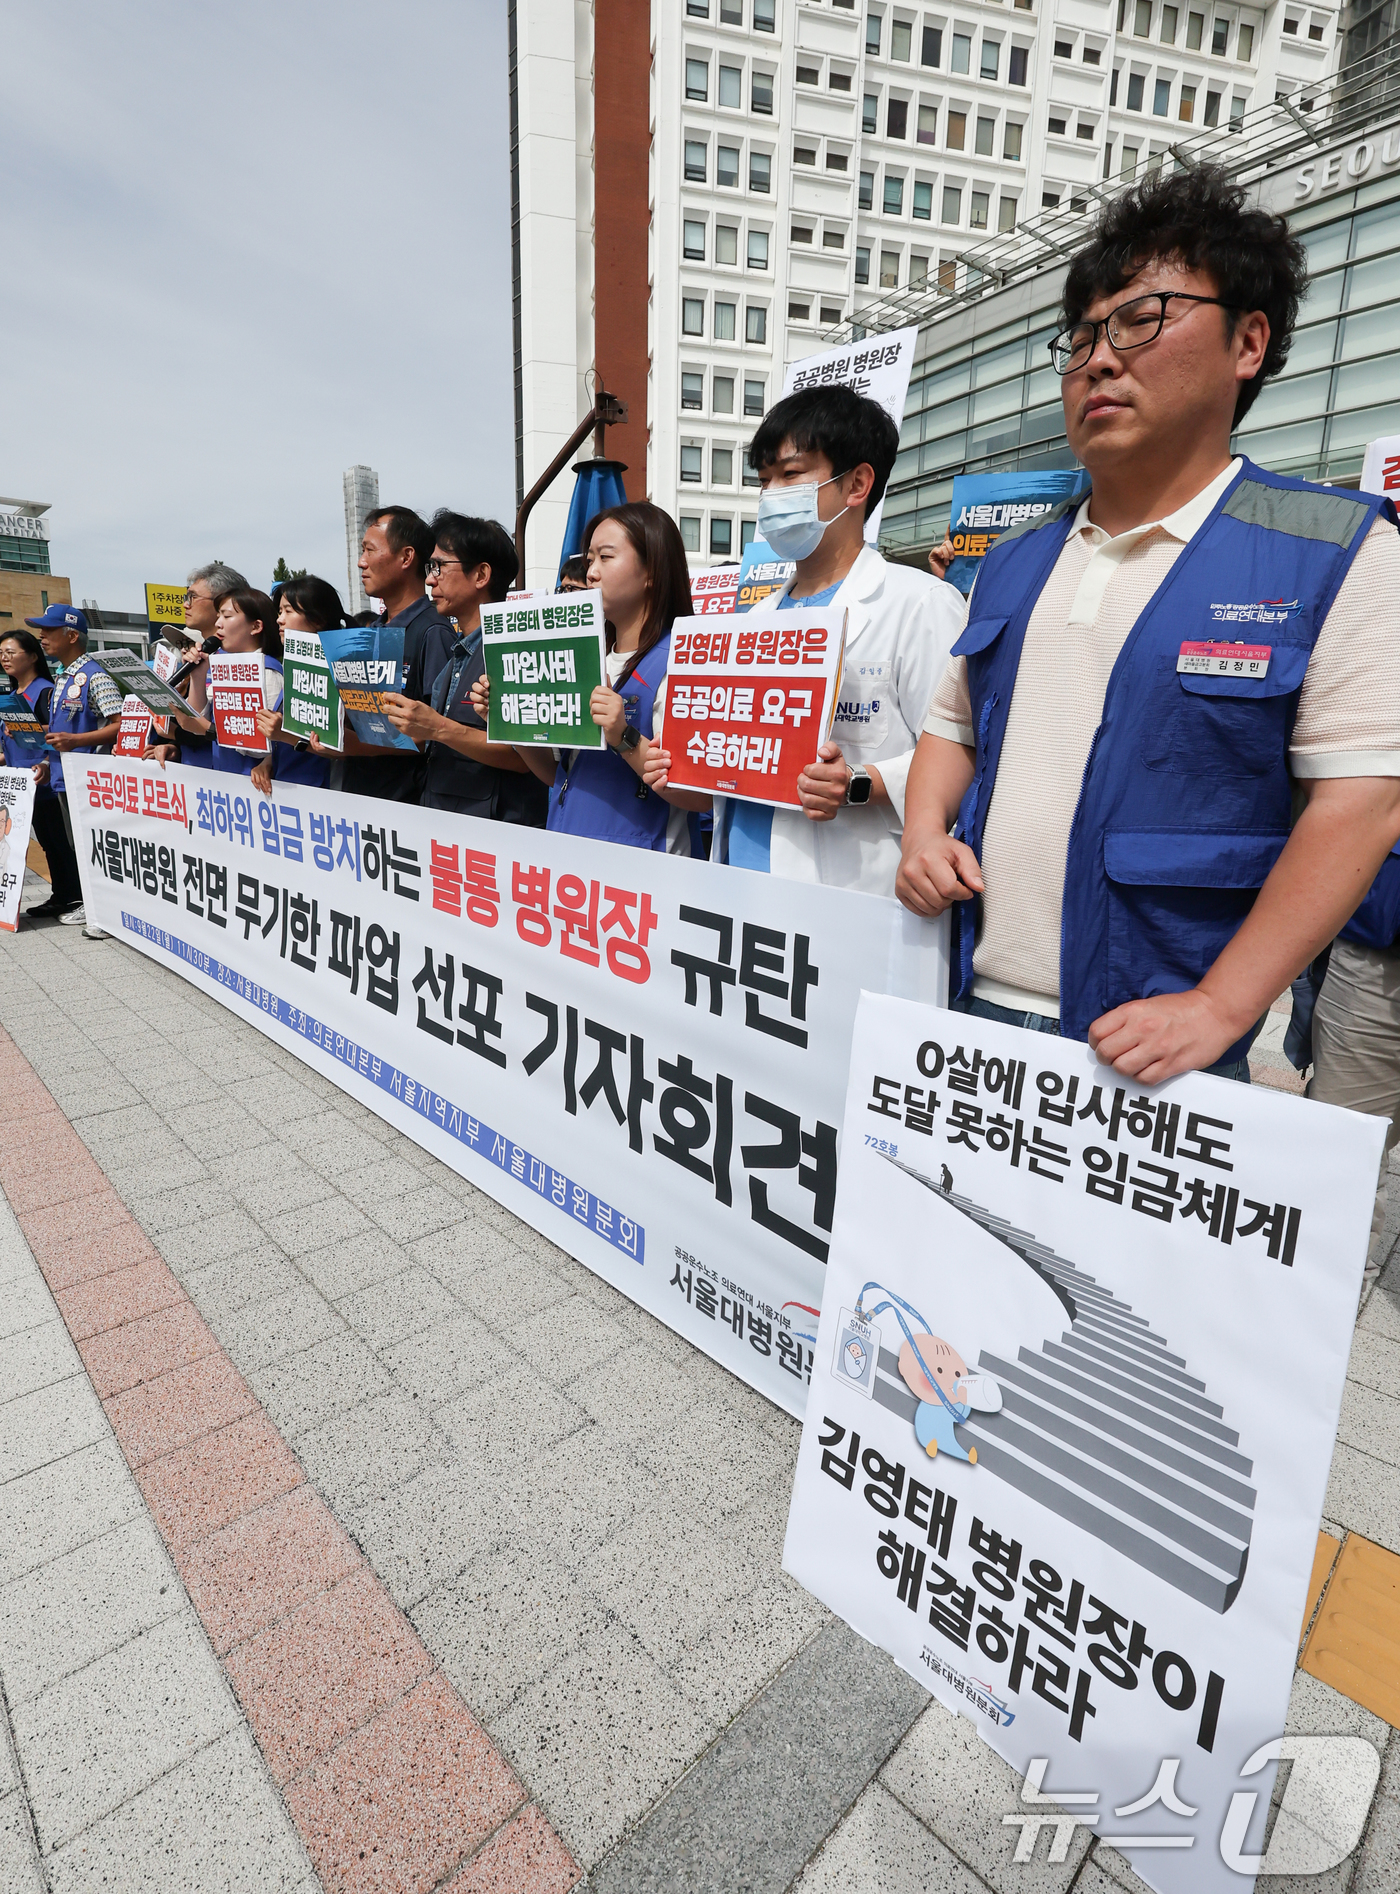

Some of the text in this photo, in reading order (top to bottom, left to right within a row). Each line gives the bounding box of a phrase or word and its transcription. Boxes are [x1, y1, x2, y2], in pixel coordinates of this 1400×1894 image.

[793, 342, 902, 392] 공공병원 병원장
[744, 562, 797, 581] 서울대
[152, 592, 185, 604] 1주차장
[155, 605, 182, 616] 공사중
[705, 596, 735, 613] 요구
[483, 613, 504, 635] 불통
[506, 609, 540, 633] 김영태
[542, 602, 595, 630] 병원장은
[1212, 610, 1289, 623] 의료연대본부
[674, 628, 828, 665] 김영태 병원장은
[211, 664, 259, 681] 김영태 병원장은
[331, 660, 397, 685] 서울대병원 답게
[501, 649, 577, 684] 파업사태
[1218, 660, 1260, 672] 김정민
[292, 668, 328, 700] 파업사태
[215, 692, 260, 712] 공공의료 요구
[290, 697, 329, 731] 해결하라!
[501, 692, 582, 727] 해결하라!
[671, 685, 813, 728] 공공의료 요구
[835, 714, 870, 723] 대학교병원
[223, 715, 255, 736] 수용하라!
[686, 730, 783, 775] 수용하라!
[1, 872, 17, 890] 요구
[86, 770, 819, 1050] 공공의료 모르쇠, 최하위 임금 방치하는 불통 병원장 규탄
[91, 828, 838, 1265] 서울대병원 전면 무기한 파업 선포 기자회견
[1035, 1070, 1234, 1172] 입사해도
[863, 1134, 900, 1158] 72호봉
[390, 1069, 480, 1146] 서울지역지부
[491, 1133, 638, 1257] 서울대병원분회
[867, 1075, 1303, 1268] 도달 못하는 임금체계
[674, 1246, 792, 1330] 공공운수노조 의료연대 서울지부
[850, 1319, 872, 1338] SNUH
[818, 1415, 1225, 1754] 김영태 병원장이
[876, 1528, 1097, 1743] 해결하라
[919, 1650, 1000, 1726] 서울대병원분회
